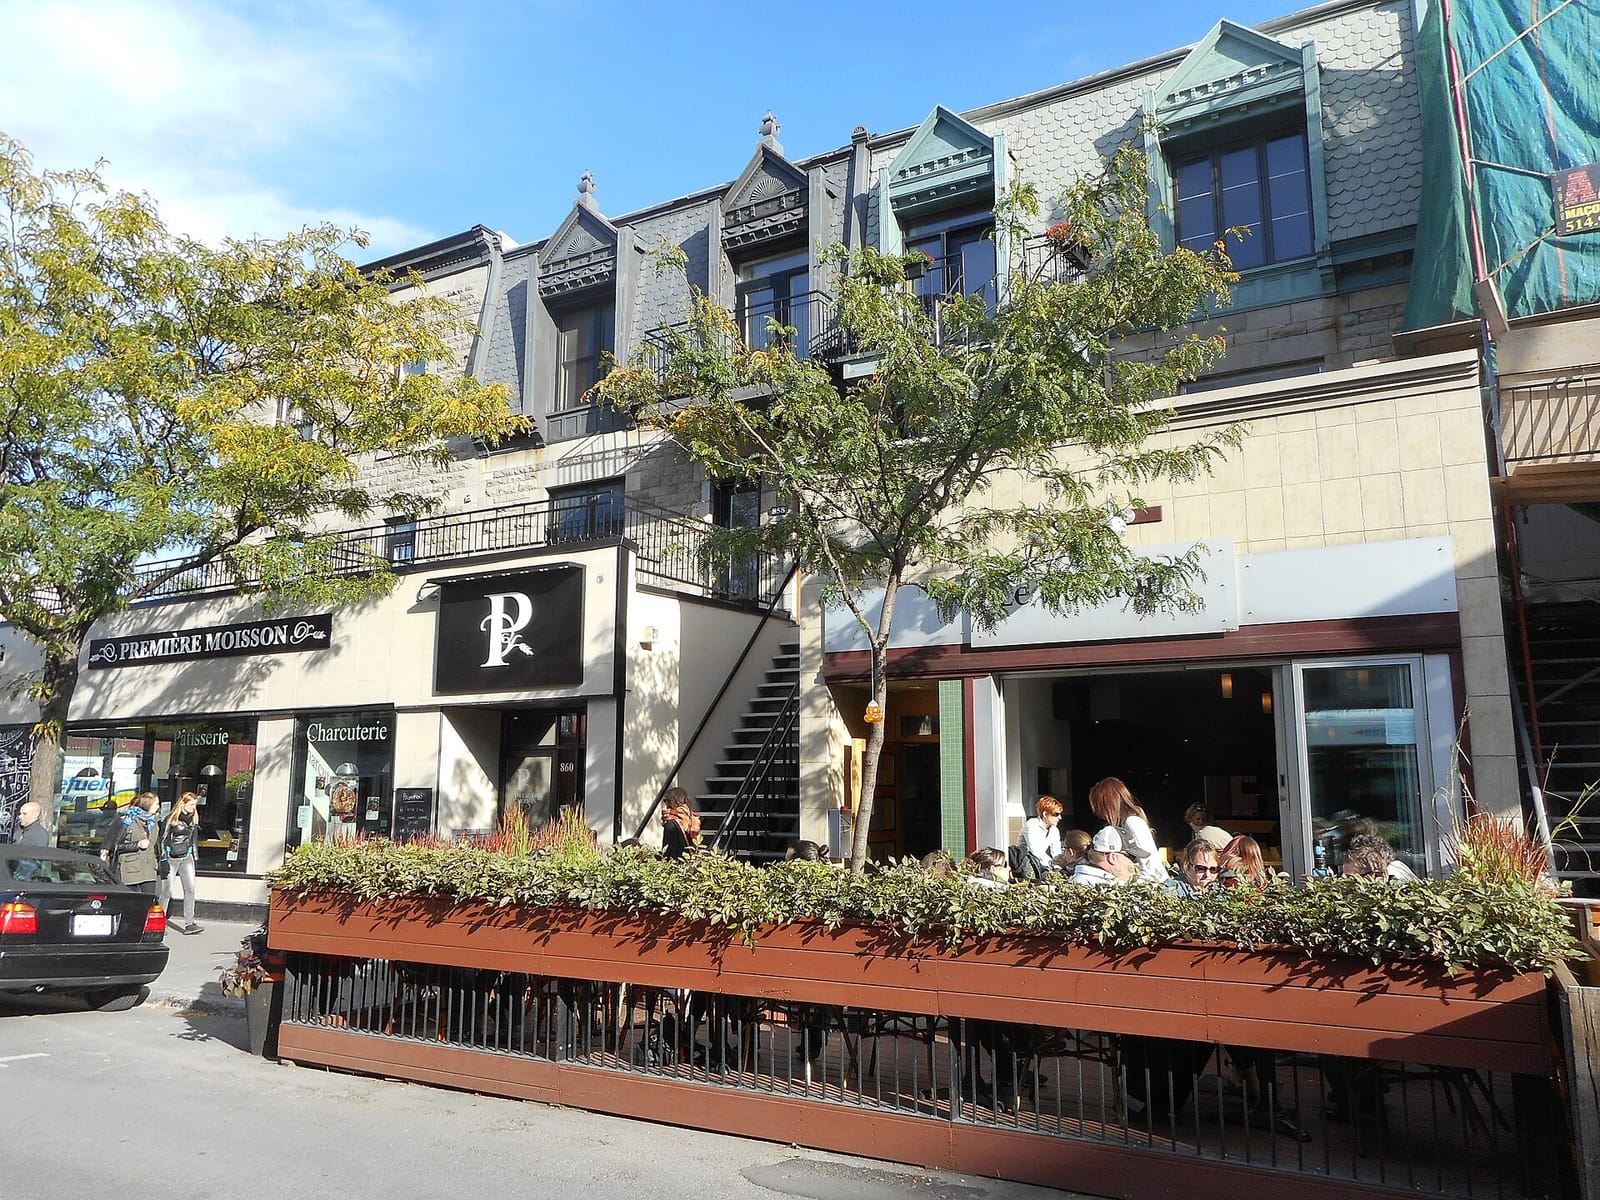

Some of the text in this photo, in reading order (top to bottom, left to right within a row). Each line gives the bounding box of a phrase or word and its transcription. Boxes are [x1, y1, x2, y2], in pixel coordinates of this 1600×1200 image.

[119, 625, 289, 660] PREMIÈRE MOISSON
[306, 721, 388, 741] Charcuterie
[560, 762, 574, 772] 860
